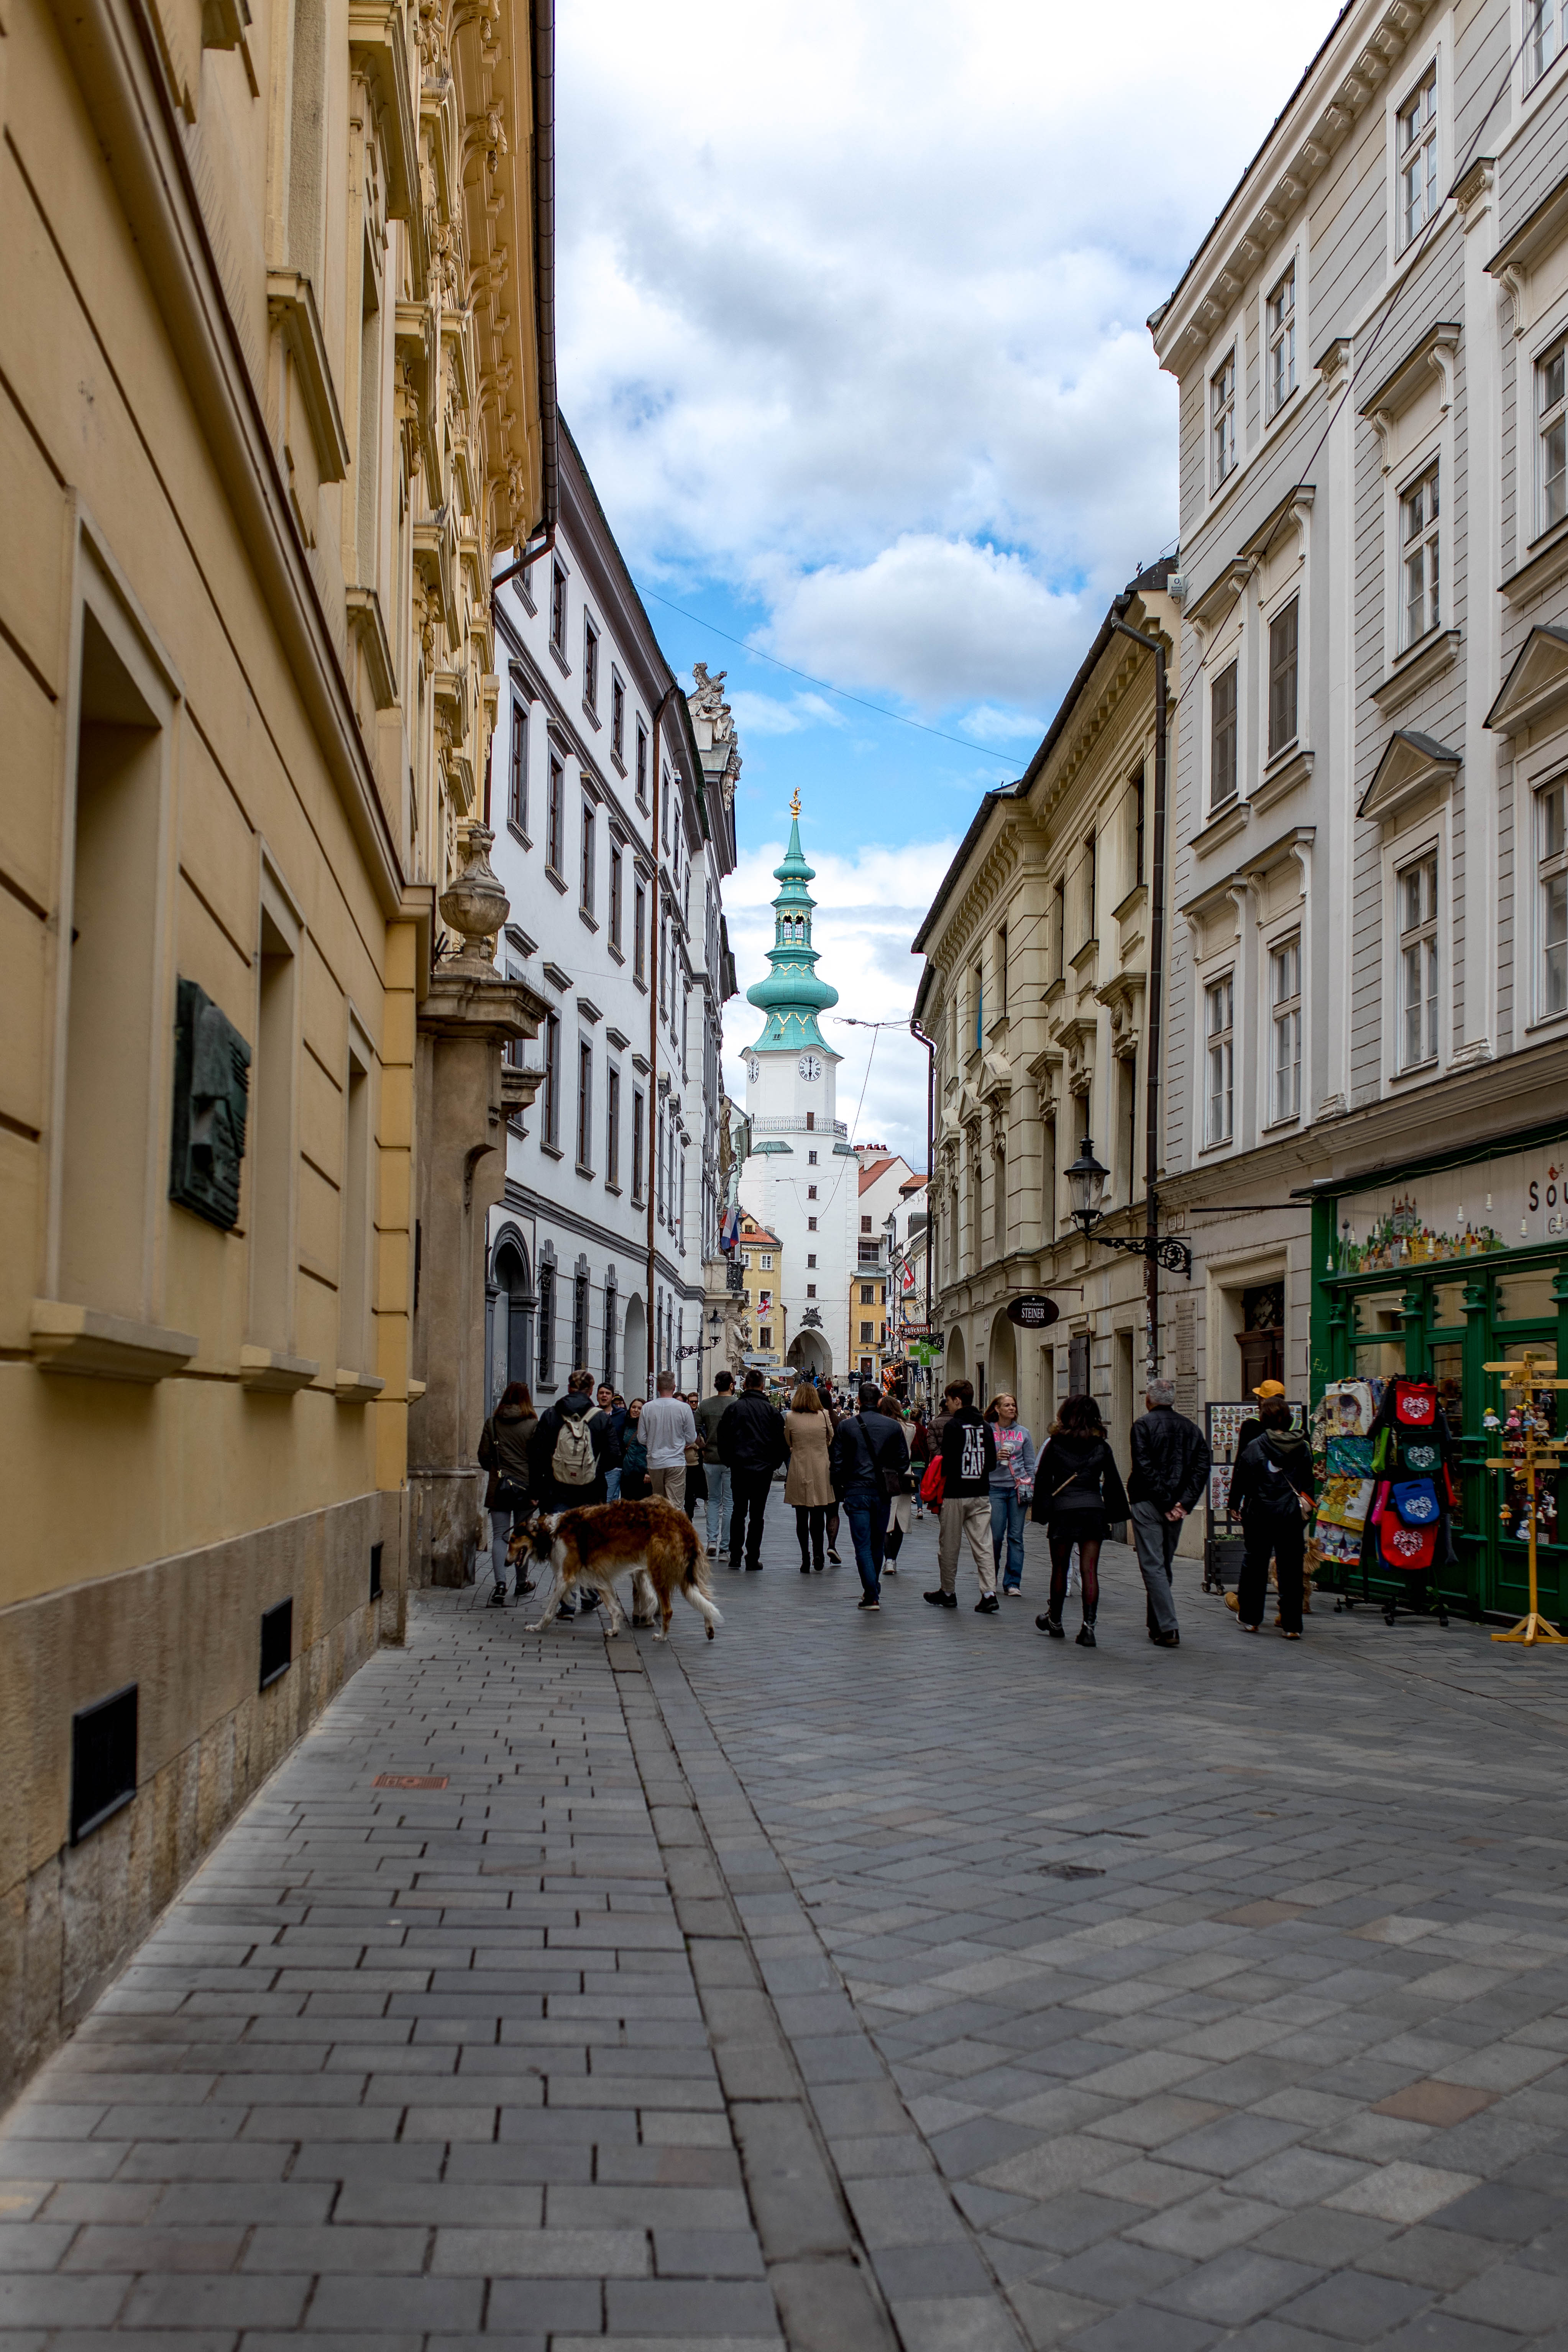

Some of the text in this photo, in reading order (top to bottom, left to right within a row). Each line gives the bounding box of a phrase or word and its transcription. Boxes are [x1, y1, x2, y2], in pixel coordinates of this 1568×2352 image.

[1021, 1308, 1044, 1318] STEINER
[963, 1429, 985, 1452] ALE
[993, 1430, 1023, 1442] ROMA
